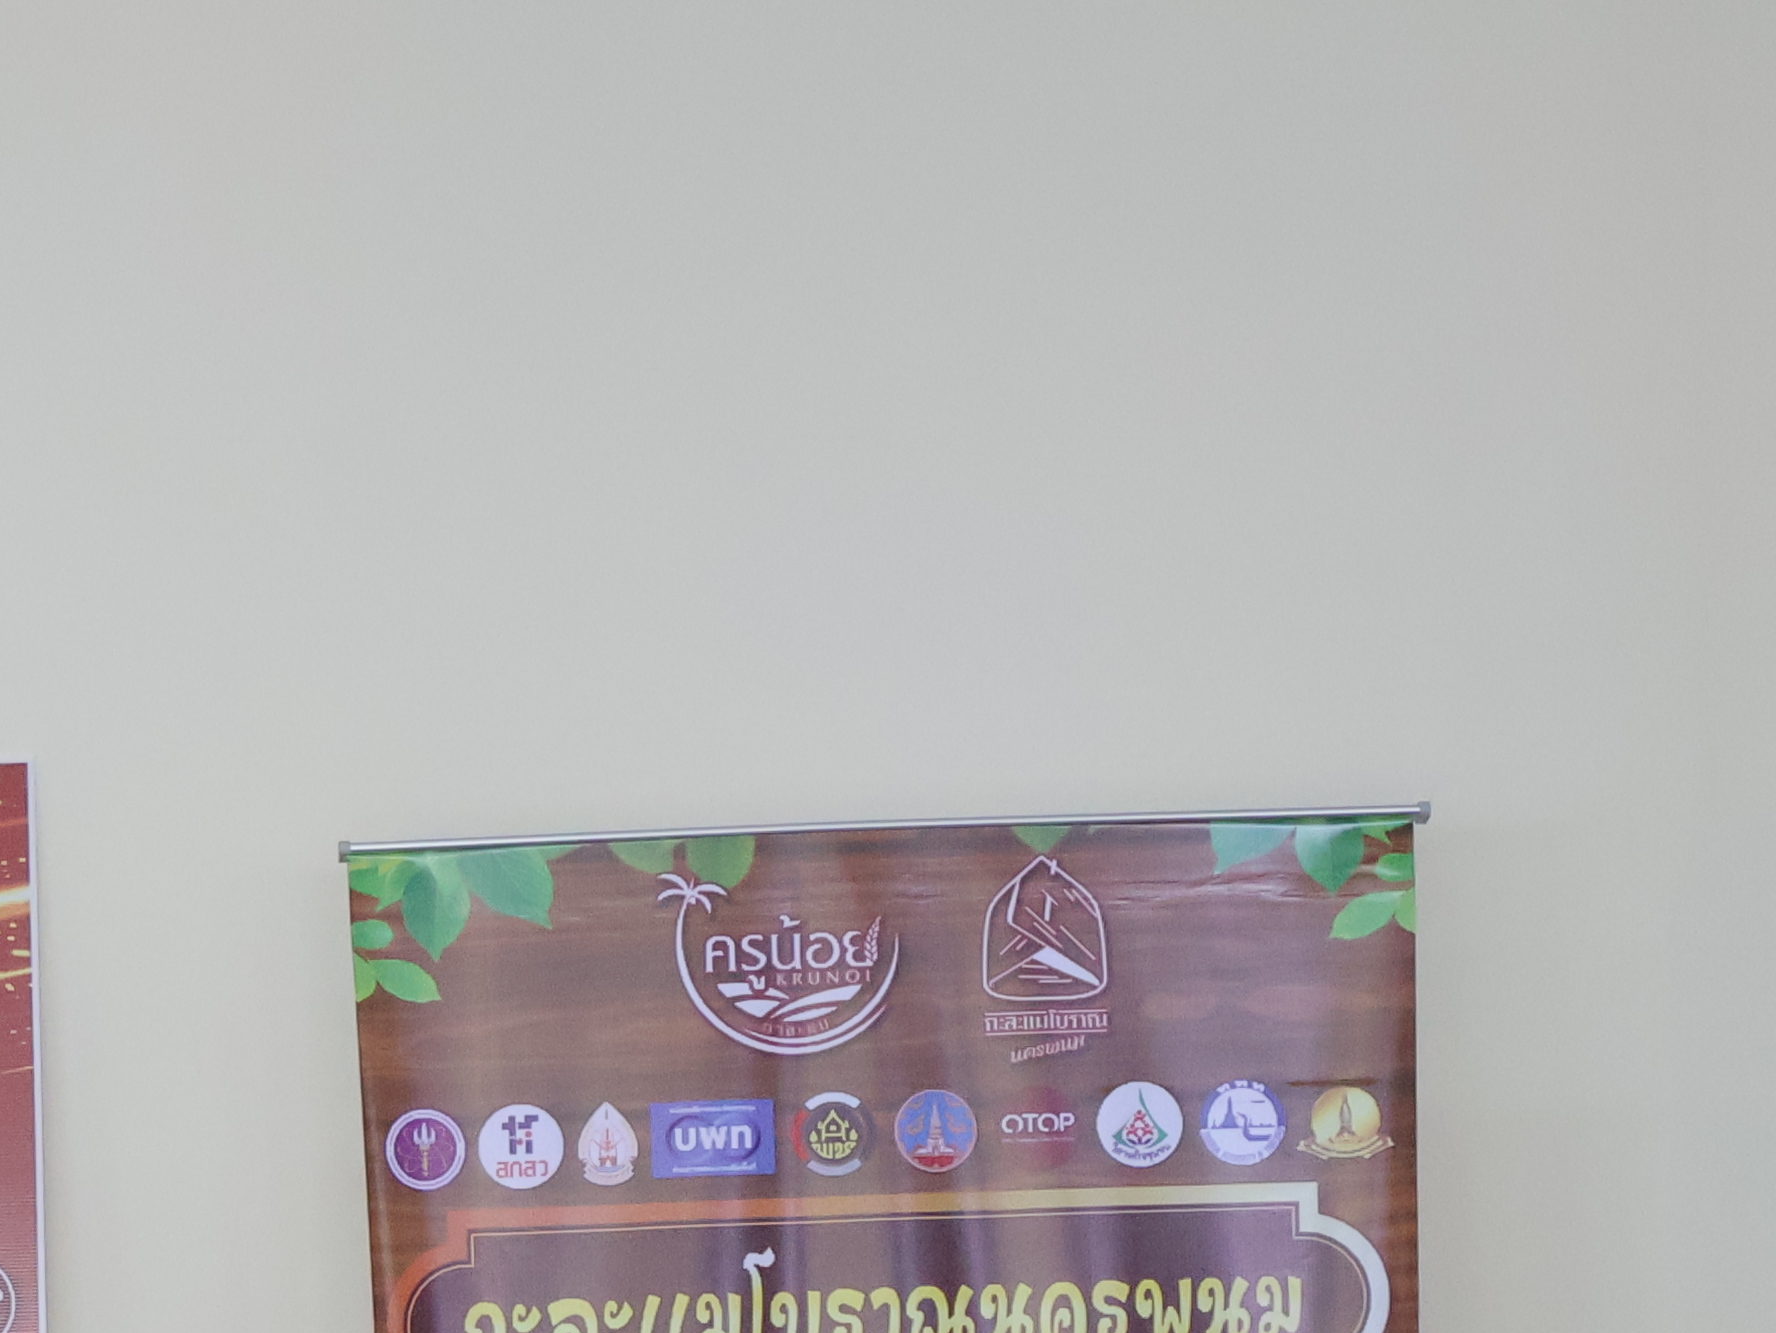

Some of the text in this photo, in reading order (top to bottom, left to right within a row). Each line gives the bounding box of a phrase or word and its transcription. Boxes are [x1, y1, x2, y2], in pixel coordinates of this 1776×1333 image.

[705, 916, 881, 990] ครูน้อย
[776, 969, 872, 985] KRUNOI
[1002, 1112, 1076, 1134] OTOP
[674, 1124, 753, 1153] บพท
[495, 1160, 549, 1179] สกสว
